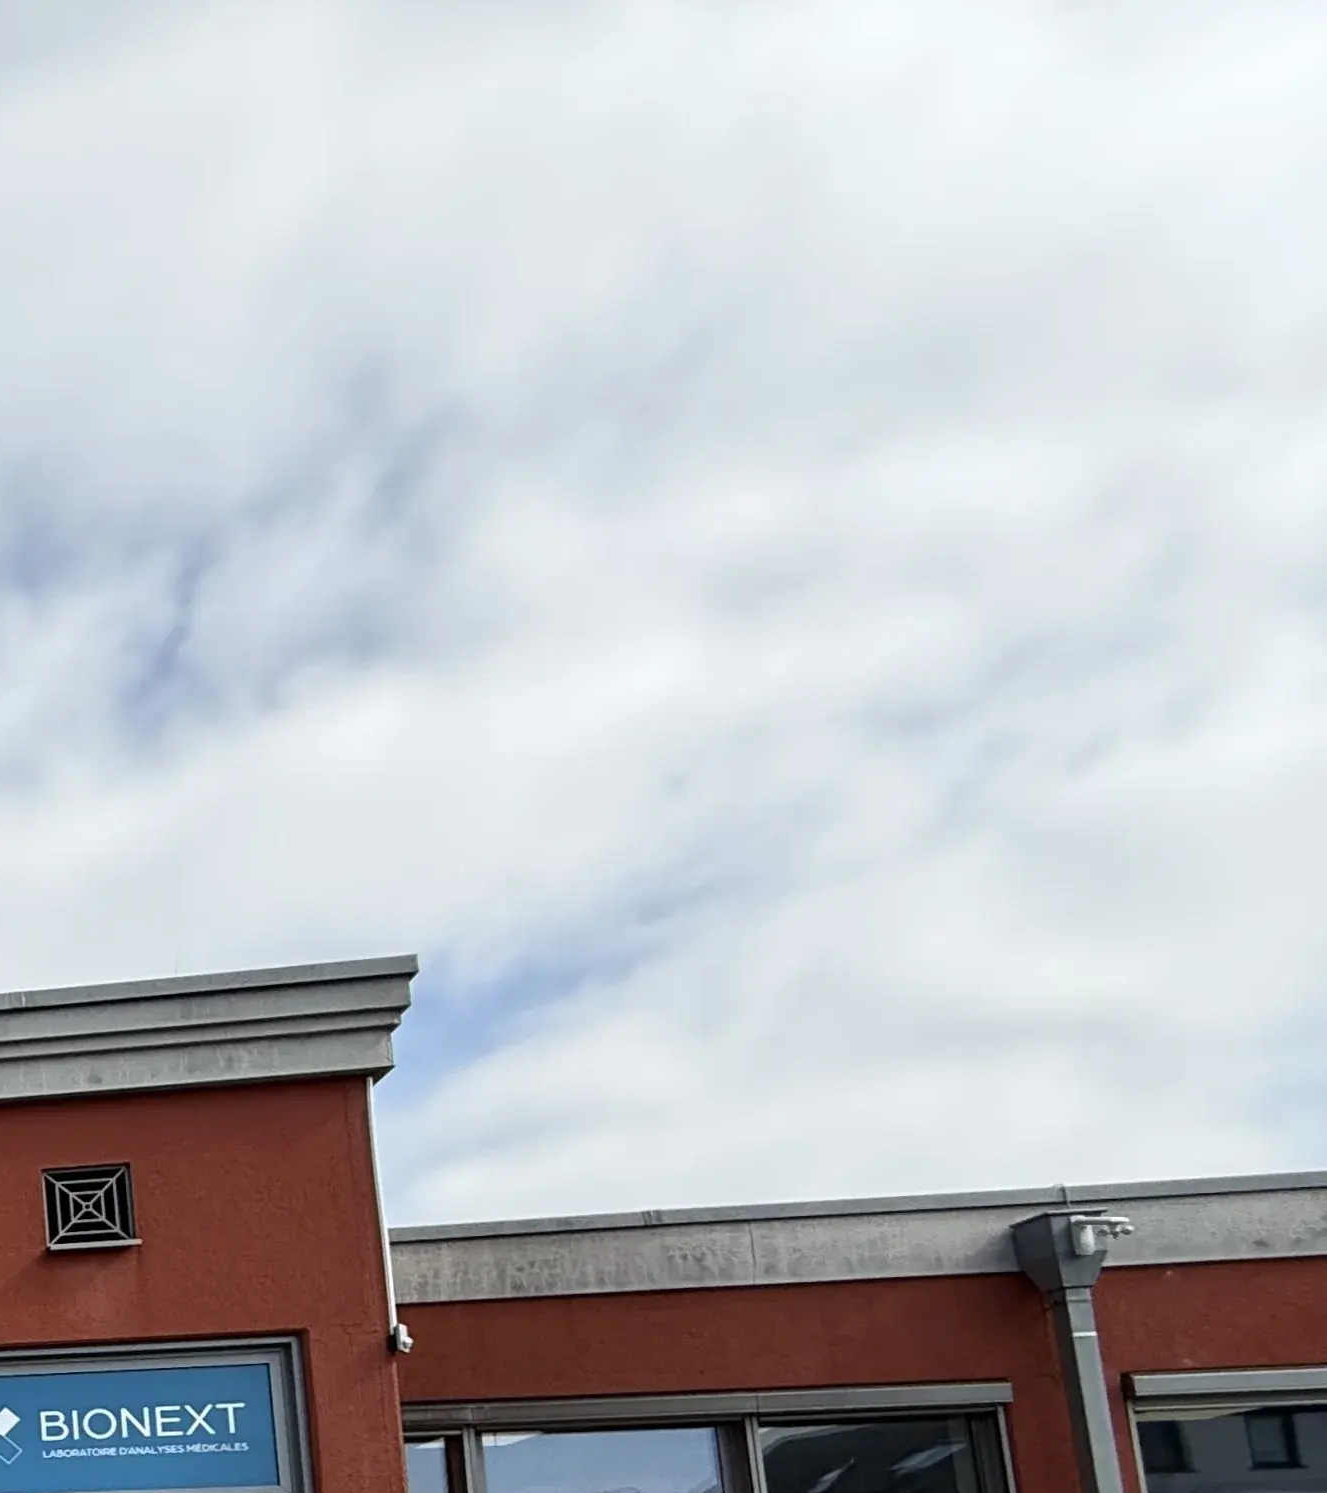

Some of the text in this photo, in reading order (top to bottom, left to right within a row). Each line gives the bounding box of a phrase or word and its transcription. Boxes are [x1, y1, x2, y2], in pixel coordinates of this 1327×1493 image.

[40, 1402, 245, 1442] BIONEXT
[42, 1441, 250, 1459] LABORATOIRE D'ANALYSES MÉDICALES
